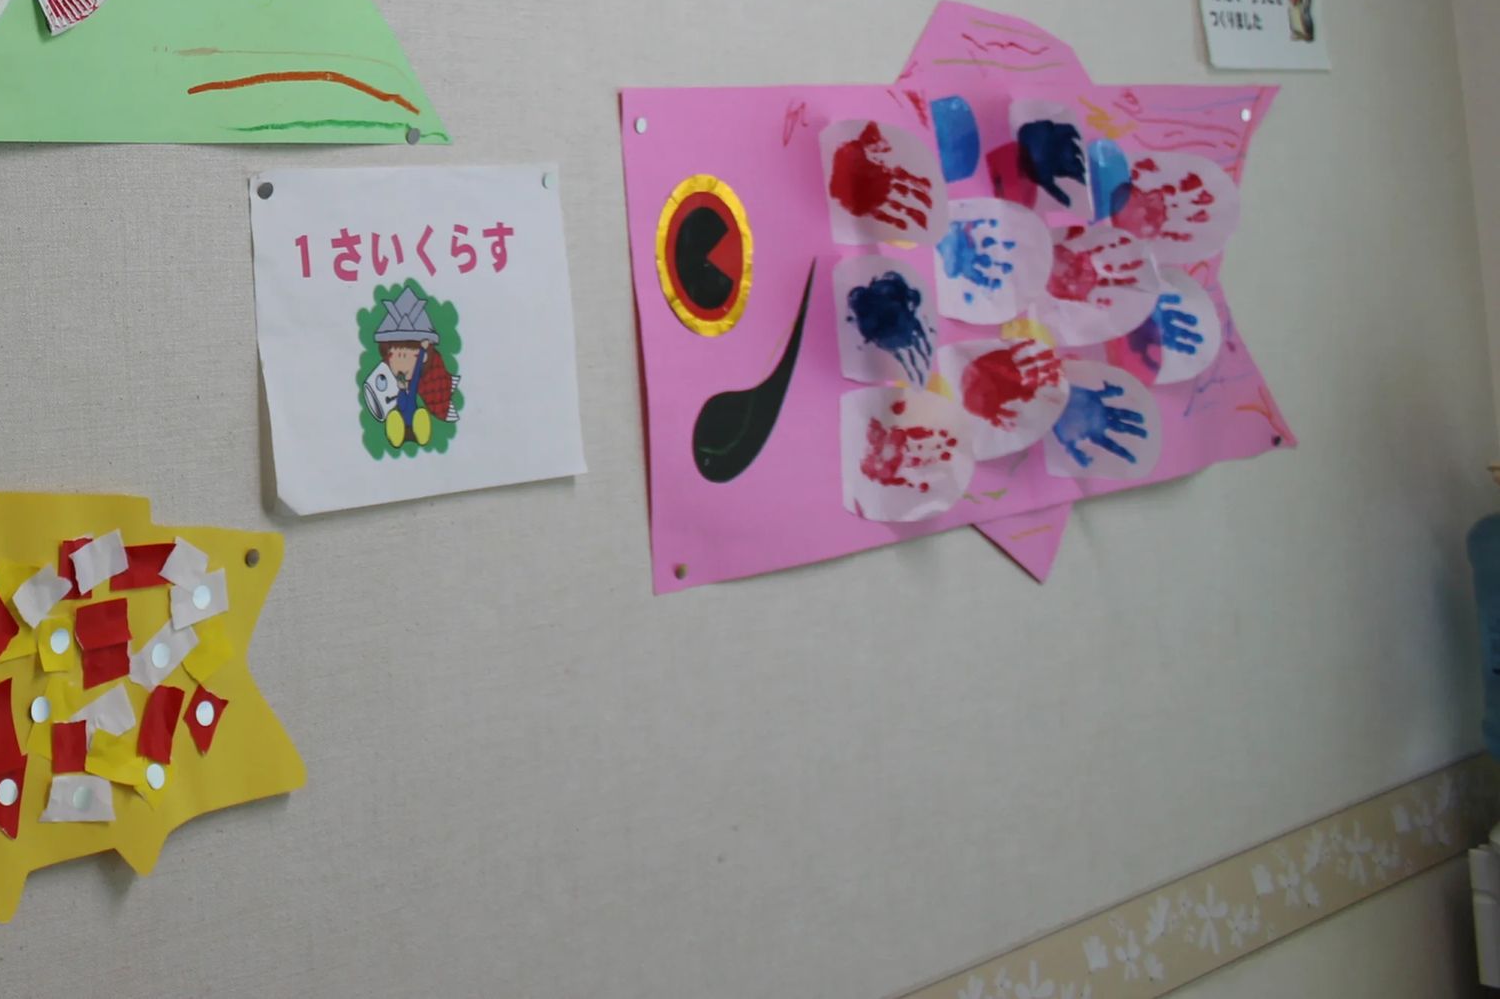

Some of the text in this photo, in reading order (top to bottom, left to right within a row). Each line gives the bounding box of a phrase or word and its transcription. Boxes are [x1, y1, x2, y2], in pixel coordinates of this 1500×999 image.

[1209, 10, 1264, 31] つくりました
[294, 221, 515, 282] 1さいくらす
